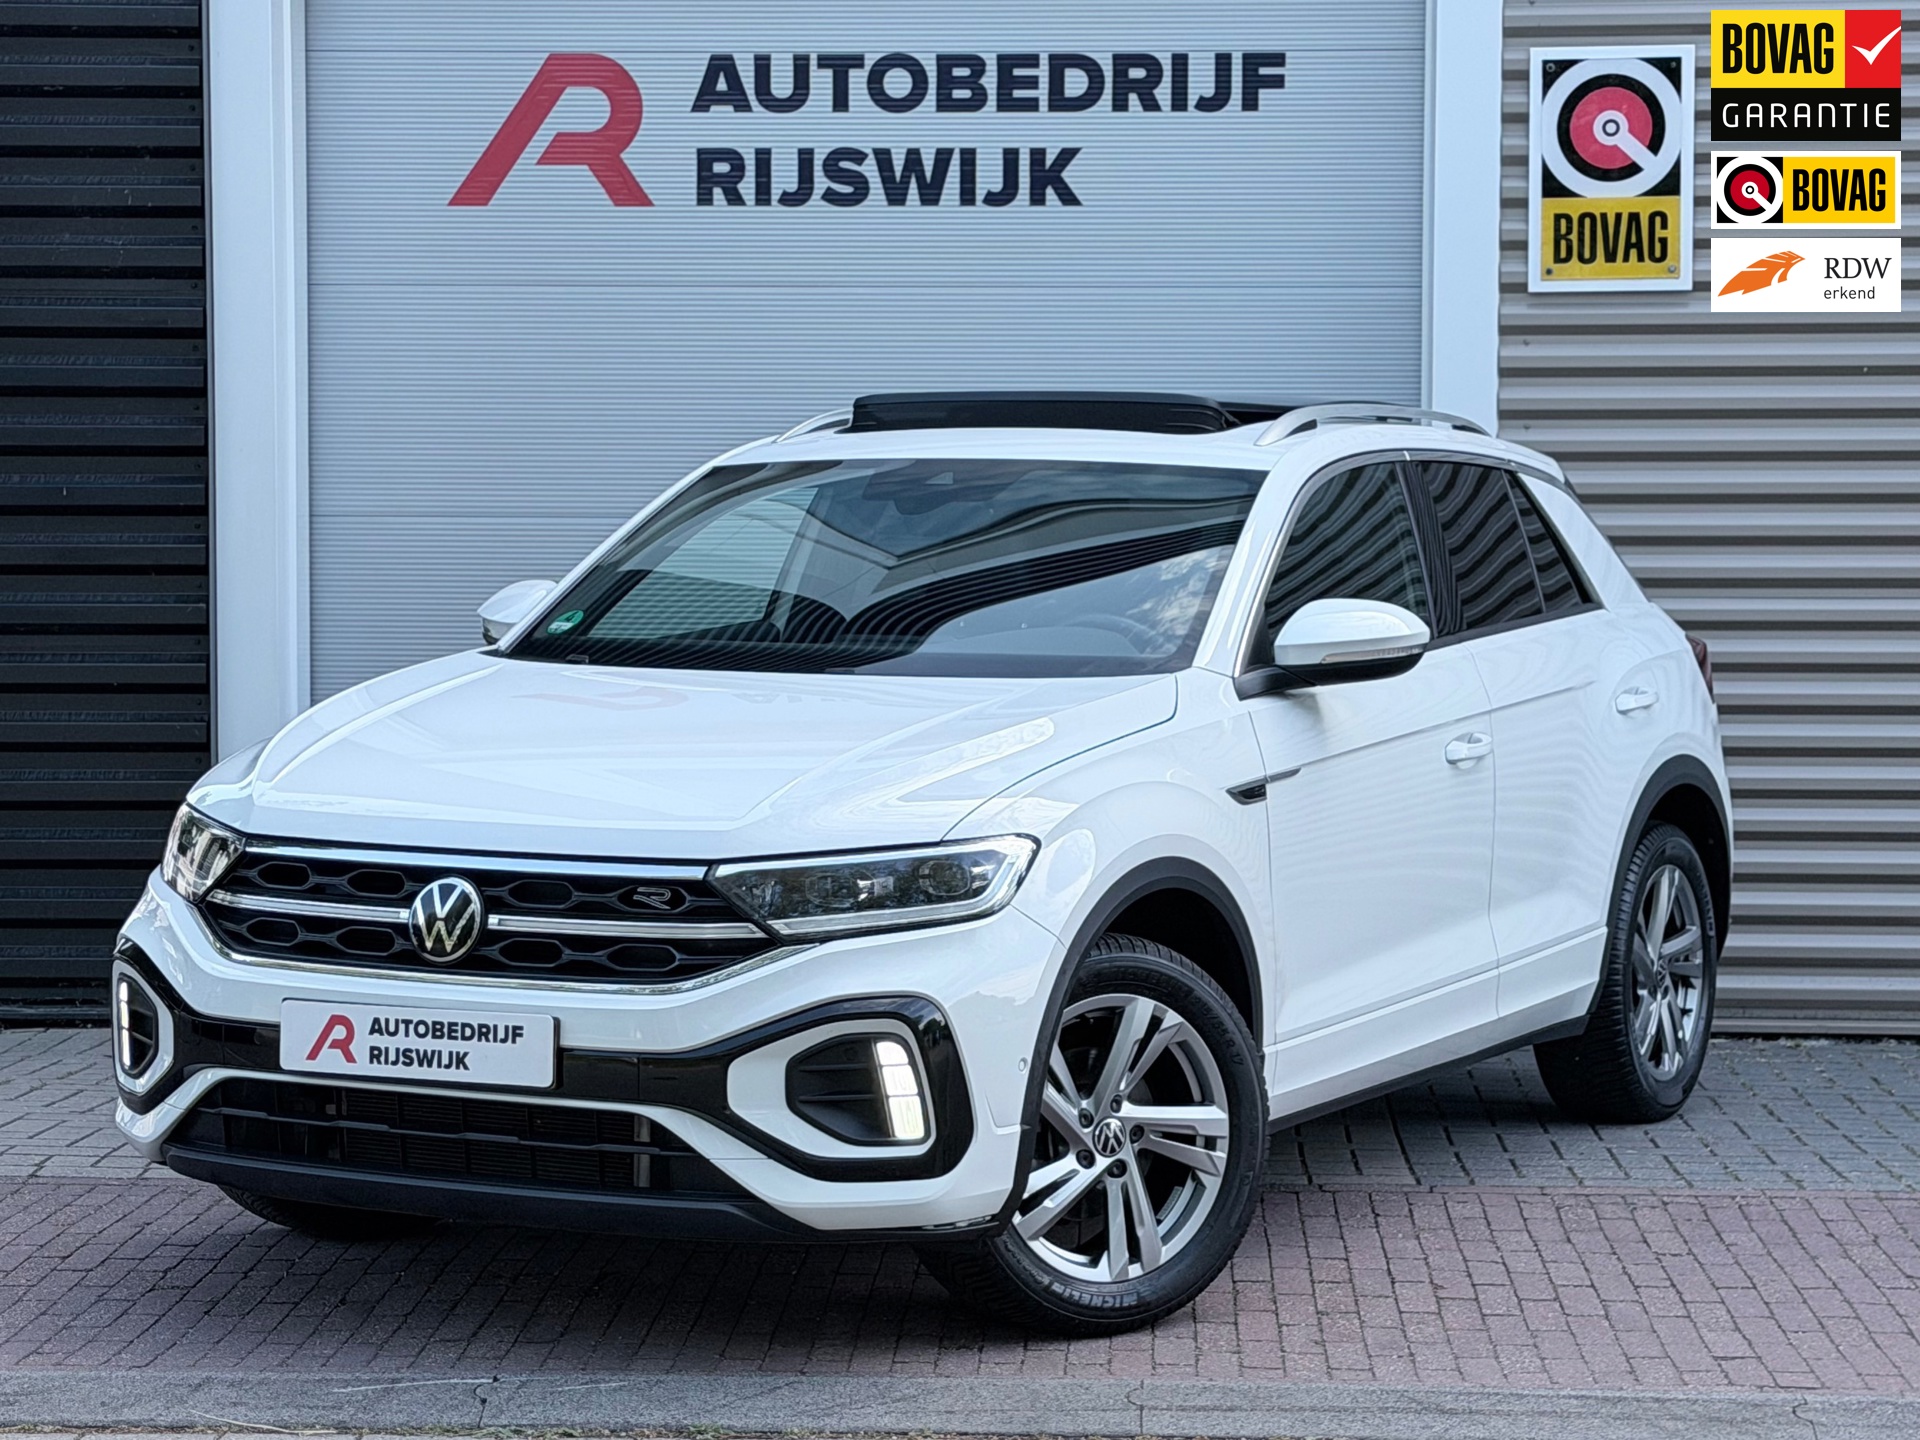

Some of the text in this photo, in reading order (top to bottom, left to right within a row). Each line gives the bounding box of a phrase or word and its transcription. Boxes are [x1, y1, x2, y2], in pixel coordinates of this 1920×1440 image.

[692, 52, 1287, 113] AUTOBEDRIJF
[697, 147, 1083, 206] RIJSWIJK
[1552, 210, 1669, 265] BOVAG
[368, 1017, 525, 1045] AUTOBEDRIJF
[368, 1046, 470, 1071] RIJSWIJK
[1051, 1281, 1138, 1308] MICHELIN
